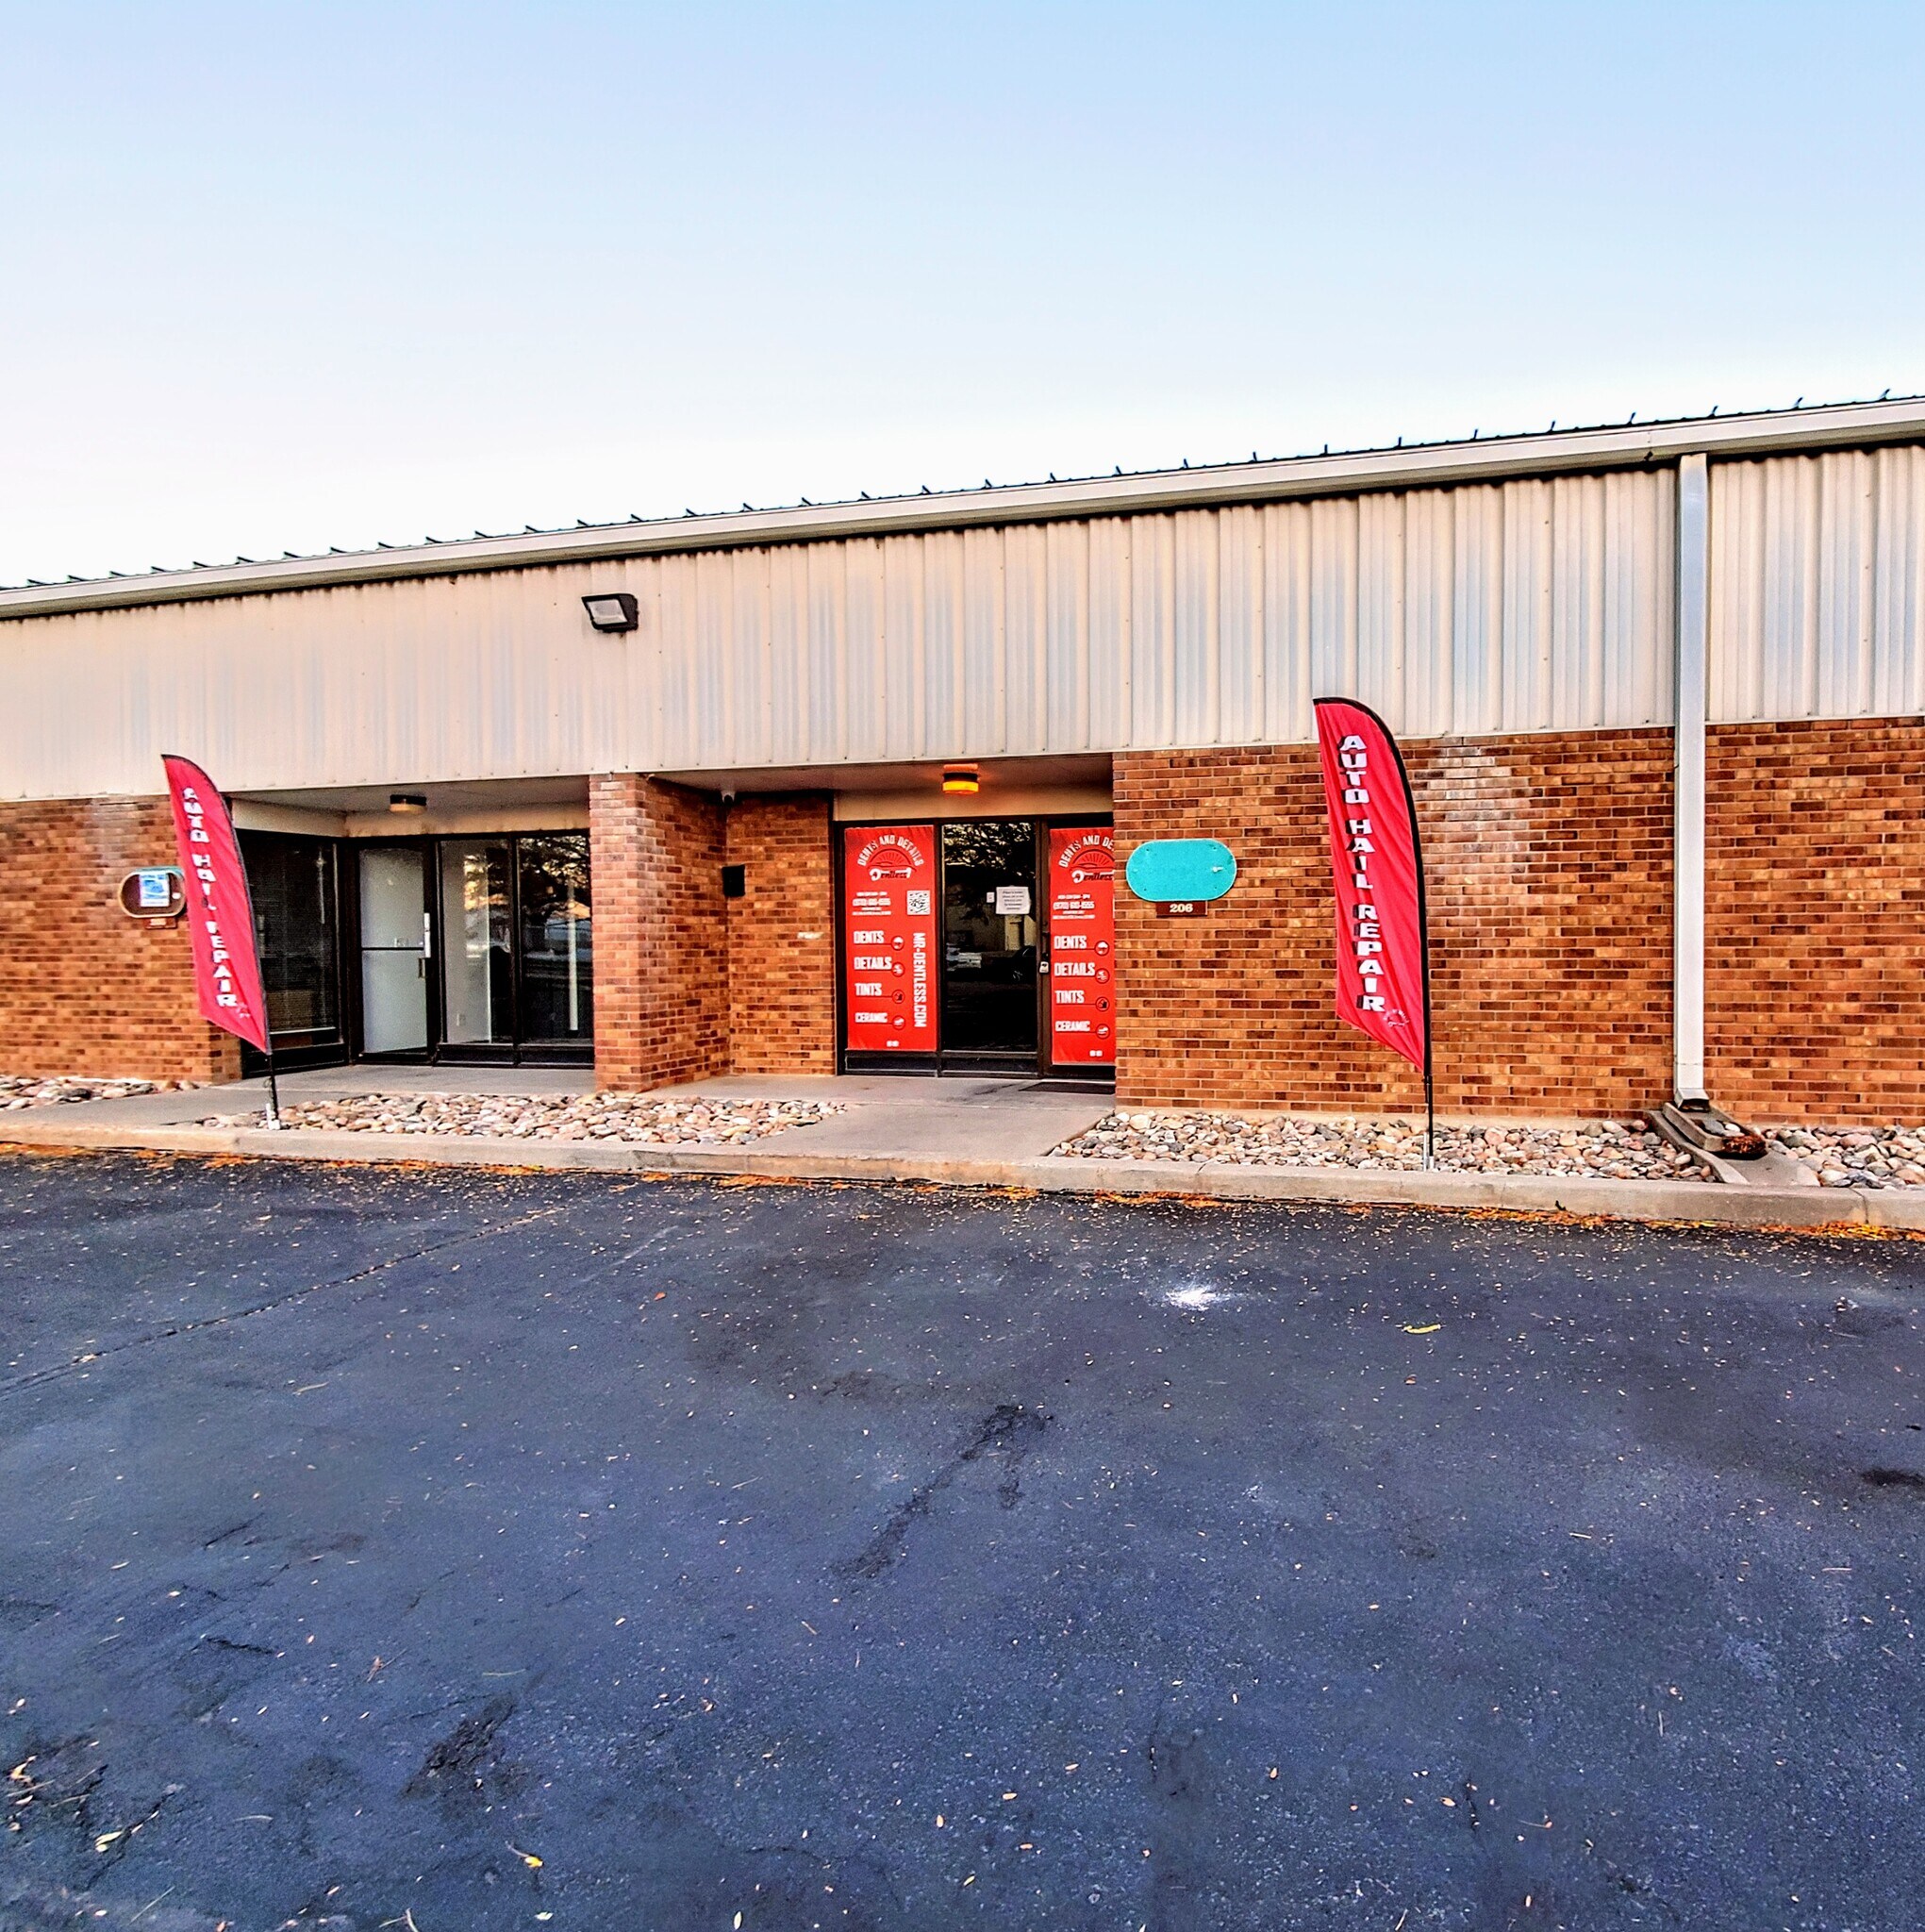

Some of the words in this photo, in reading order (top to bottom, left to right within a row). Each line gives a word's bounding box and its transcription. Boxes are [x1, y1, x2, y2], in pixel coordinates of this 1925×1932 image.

[1338, 735, 1369, 804] AUTO
[183, 788, 208, 843] AUTO
[857, 841, 878, 866] DENTS
[879, 835, 895, 845] AND
[897, 837, 924, 866] DETAILS
[1058, 841, 1082, 867] DENTS
[1083, 835, 1100, 845] AND
[1347, 820, 1375, 890] HAIL
[1170, 903, 1193, 913] 206
[854, 931, 884, 943] DENTS
[1054, 936, 1087, 949] DENTS
[855, 957, 892, 969] DETAILS
[1352, 904, 1385, 1011] REPAIR
[1054, 962, 1095, 976] DETAILS
[913, 933, 927, 1027] MR-DENTLESS.COM
[855, 983, 882, 995] TINTS
[1055, 991, 1085, 1003] TINTS
[855, 1012, 888, 1023] CERAMIC
[1055, 1021, 1090, 1031] CERAMIC
